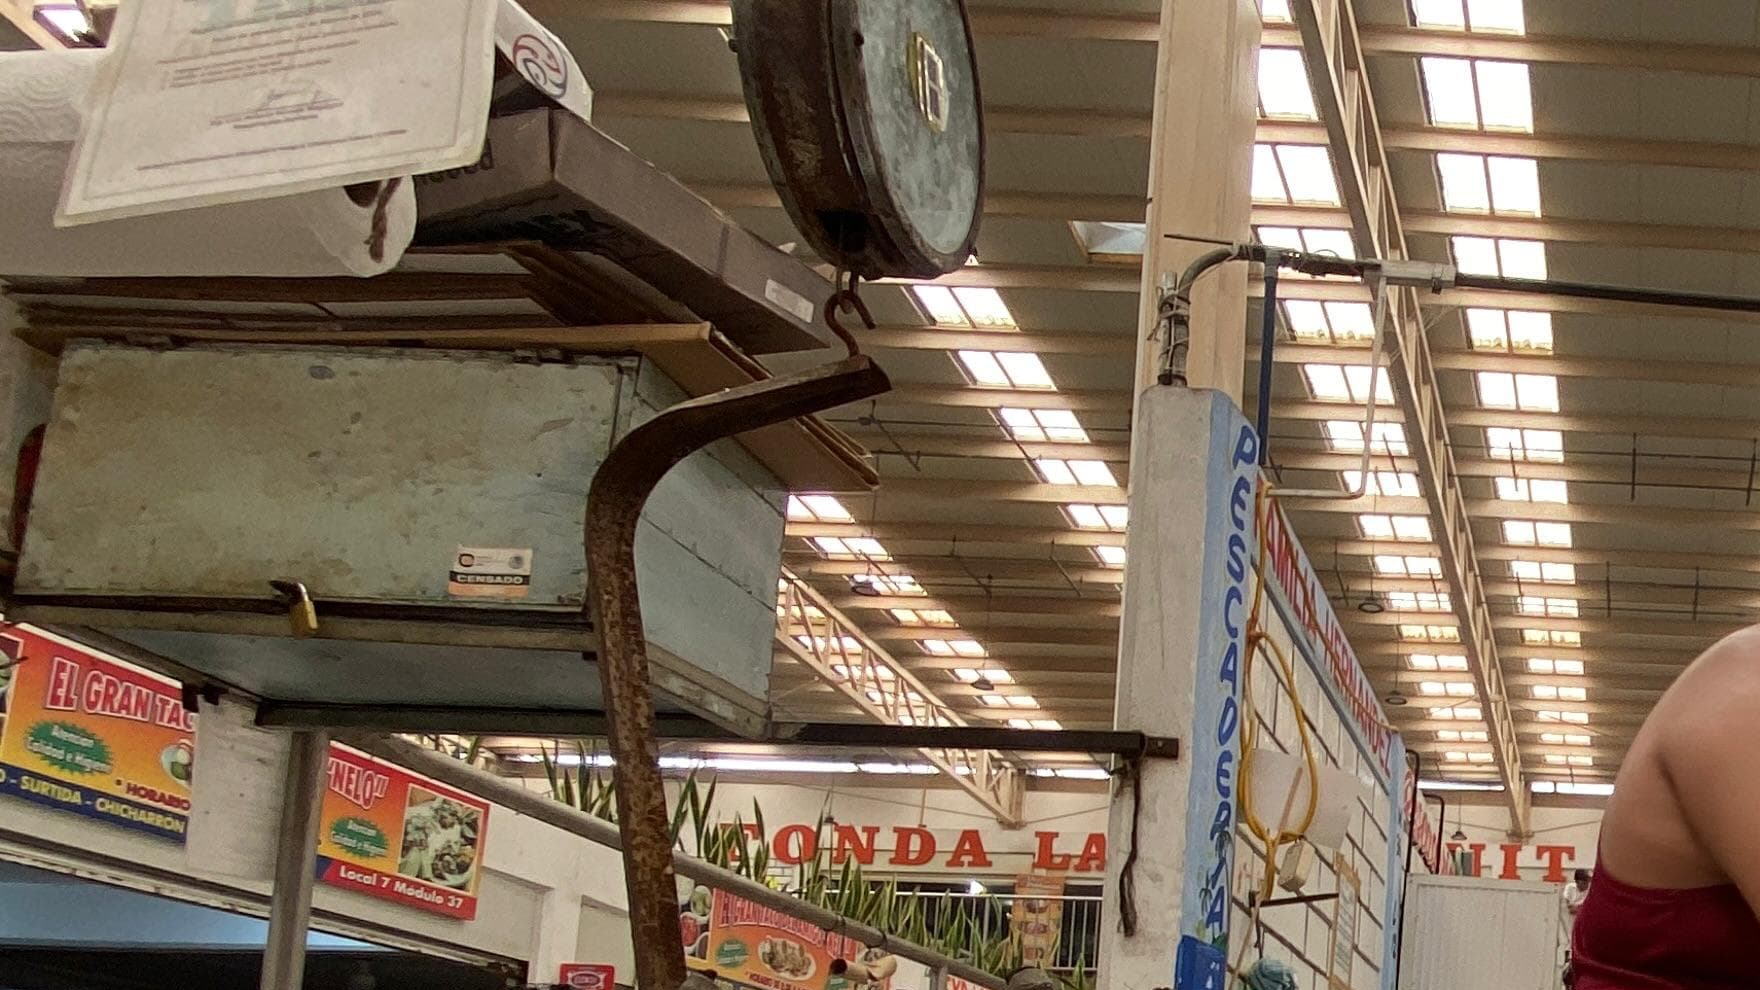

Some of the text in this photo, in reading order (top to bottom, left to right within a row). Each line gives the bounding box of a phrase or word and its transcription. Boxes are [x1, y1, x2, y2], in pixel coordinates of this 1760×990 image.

[457, 573, 524, 585] CENSADO
[46, 657, 79, 711] EL
[83, 670, 153, 722] GRAN
[1205, 424, 1257, 935] PESCADERIA
[20, 775, 83, 805] SURTIDA
[126, 782, 191, 811] HORARIO
[339, 865, 377, 885] Local
[381, 877, 391, 888] 7
[447, 896, 463, 909] 37
